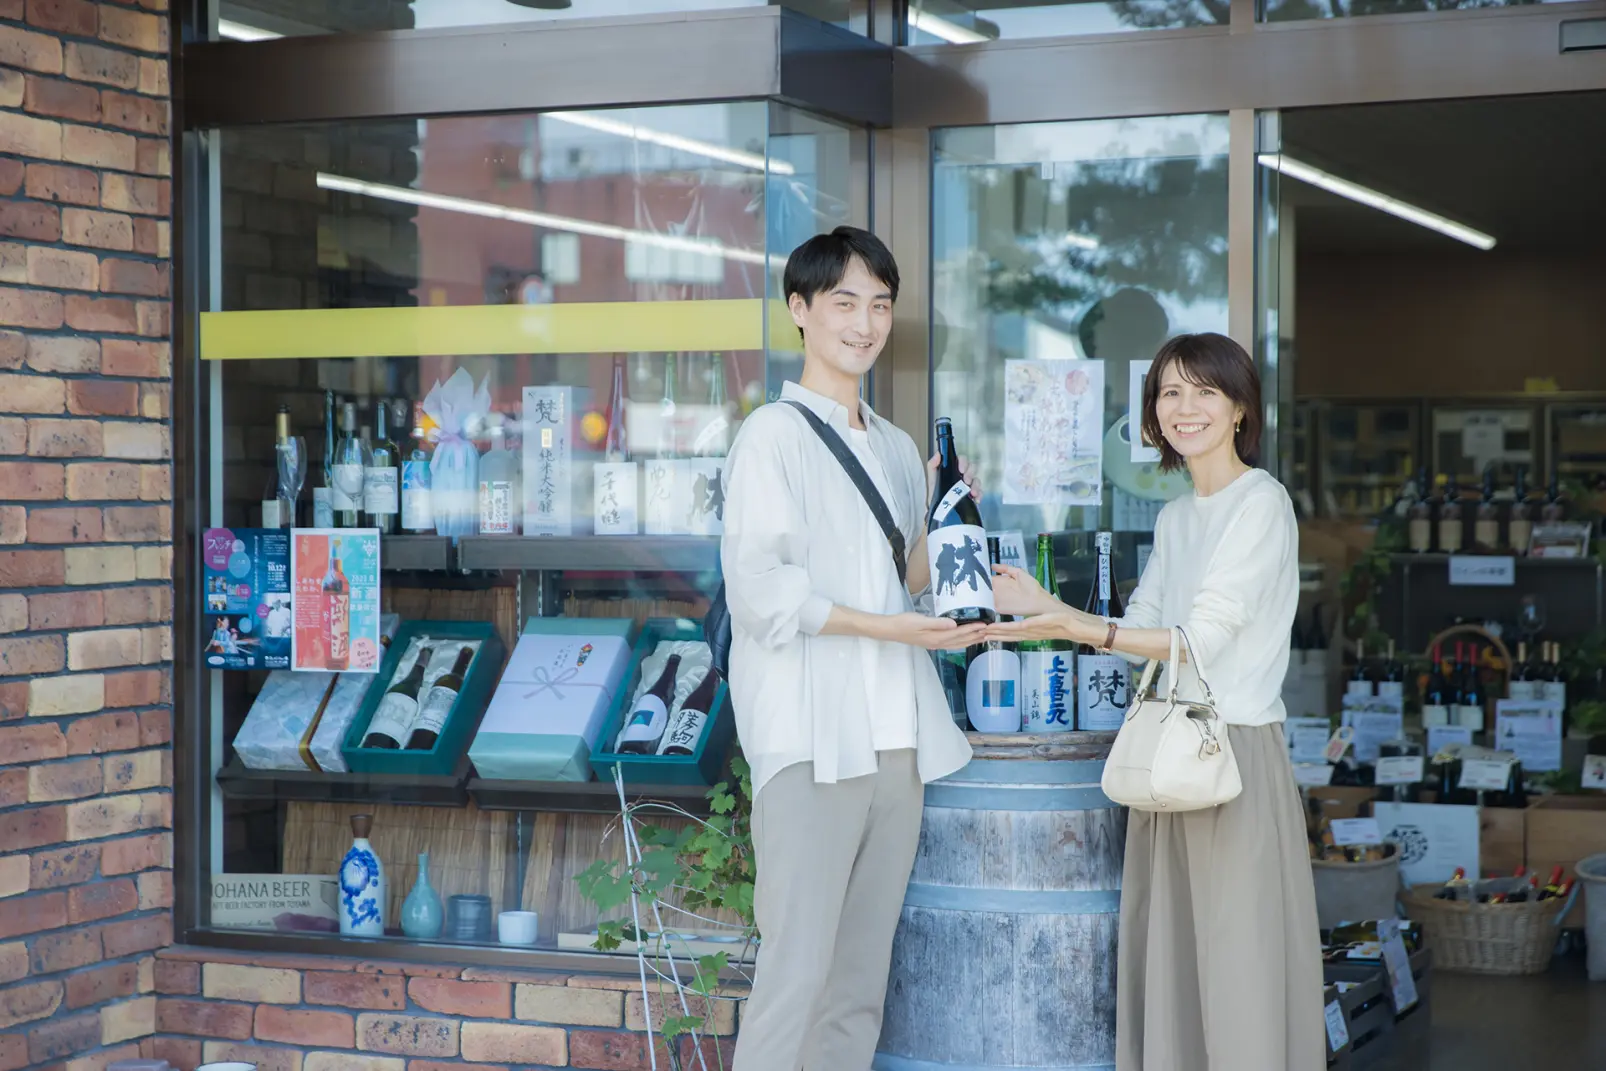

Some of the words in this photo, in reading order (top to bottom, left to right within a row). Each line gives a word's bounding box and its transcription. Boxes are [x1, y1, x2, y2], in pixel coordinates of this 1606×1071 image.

[535, 399, 558, 424] 梵
[538, 449, 556, 513] 純米大吟醸
[1043, 655, 1070, 725] 上喜元
[1088, 669, 1126, 709] 梵
[272, 881, 310, 897] BEER
